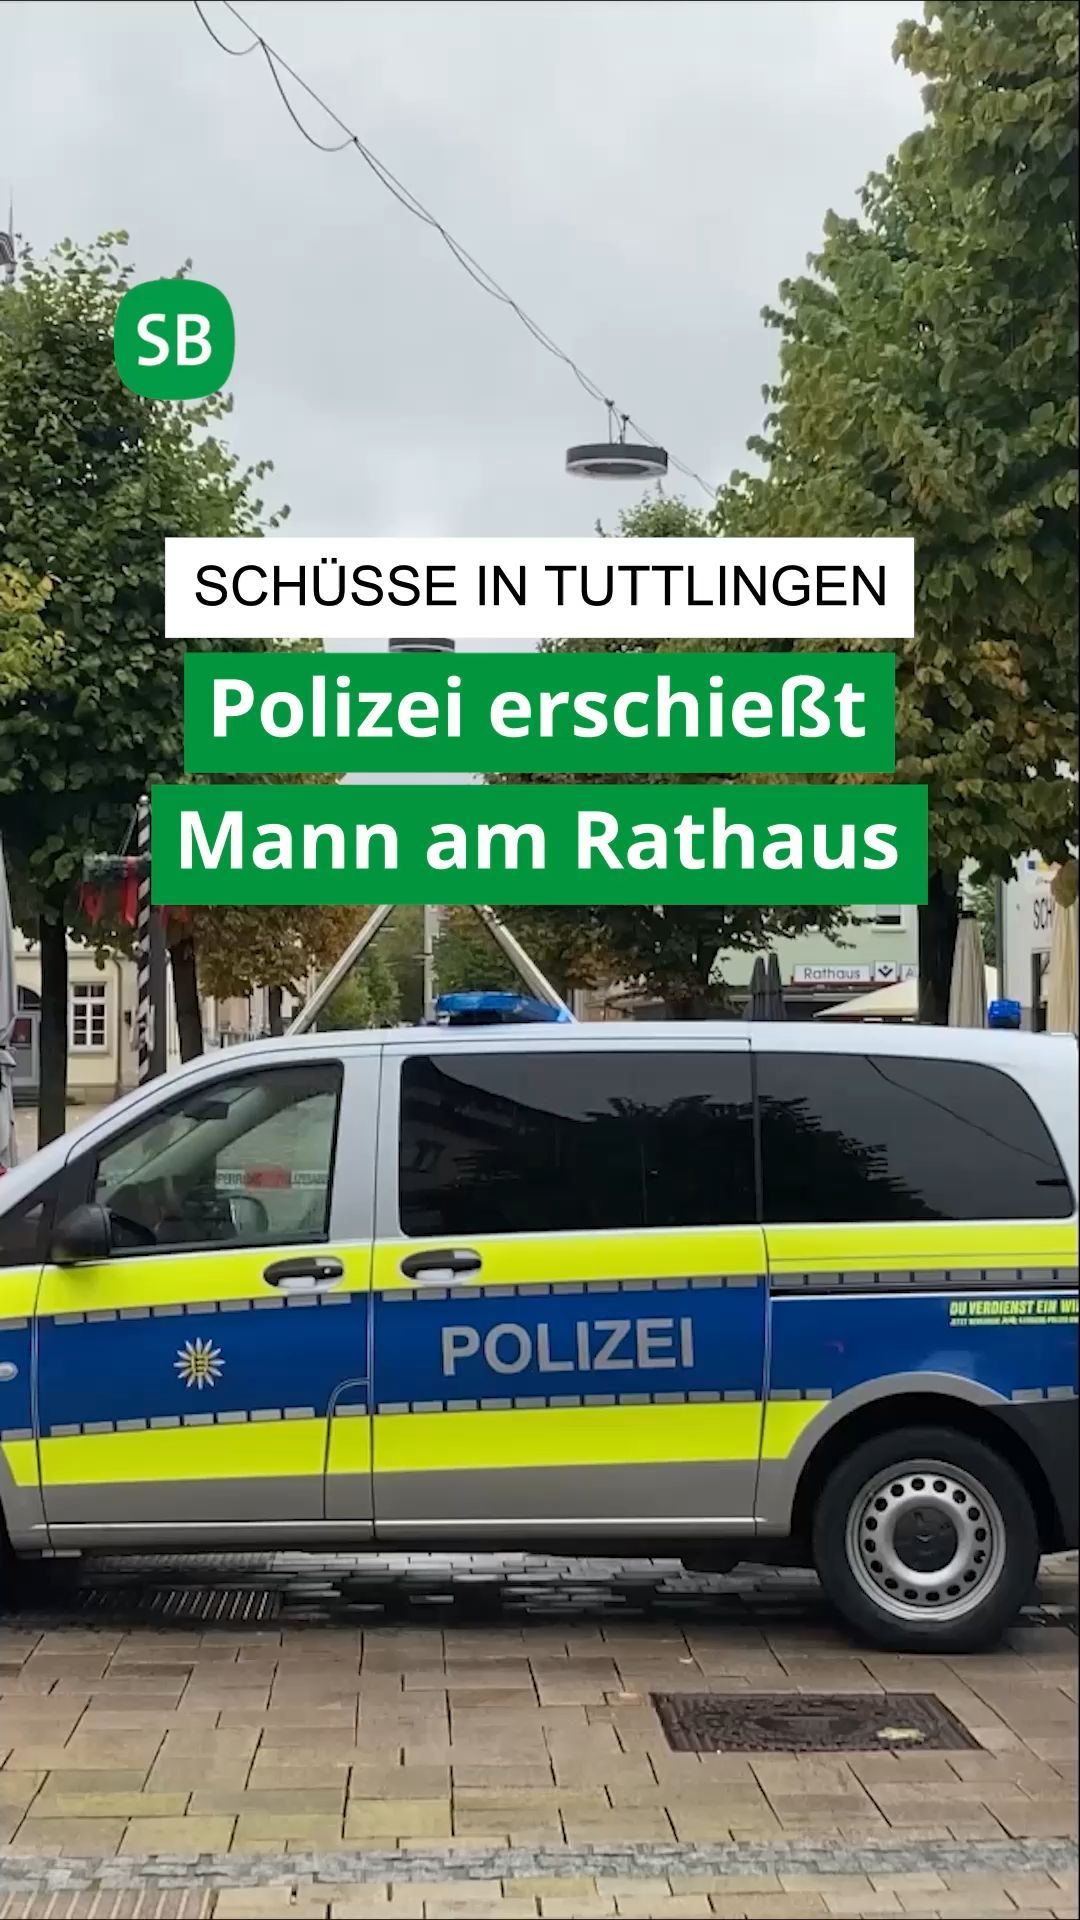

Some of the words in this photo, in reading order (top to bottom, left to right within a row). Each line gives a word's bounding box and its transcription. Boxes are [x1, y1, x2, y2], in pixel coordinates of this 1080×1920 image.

[803, 967, 861, 980] Rathaus
[949, 1300, 967, 1316] DU
[968, 1300, 1035, 1315] VERDIENST
[1036, 1299, 1058, 1314] EIN
[441, 1317, 694, 1376] POLIZEI
